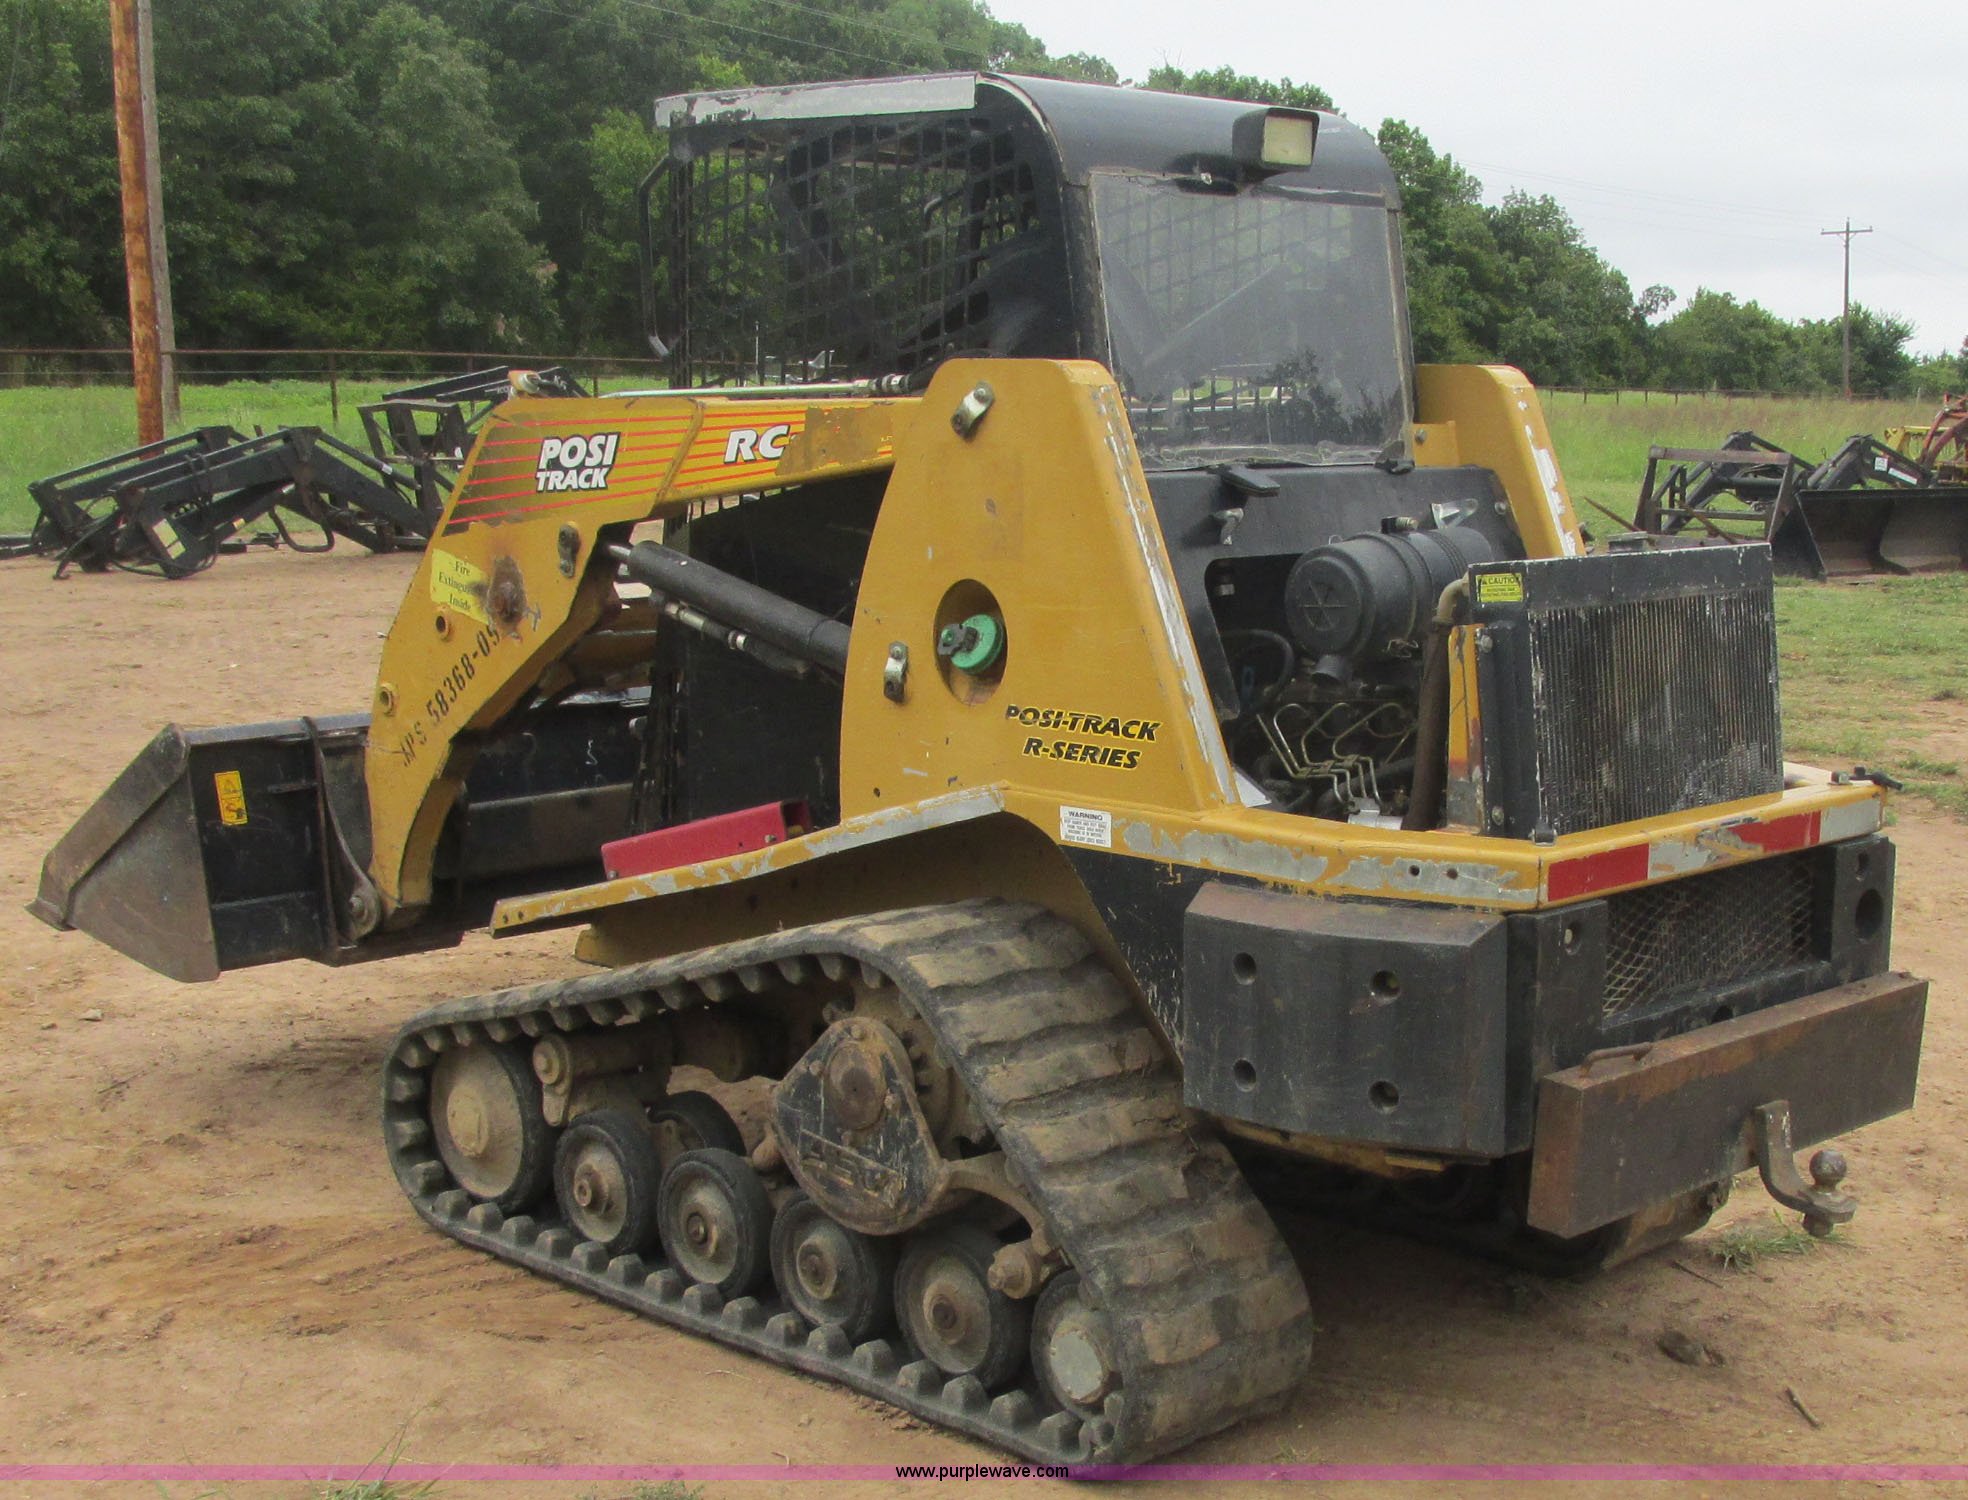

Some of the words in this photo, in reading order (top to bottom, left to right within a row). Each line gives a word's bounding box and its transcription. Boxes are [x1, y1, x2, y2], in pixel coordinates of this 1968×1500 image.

[538, 432, 620, 470] POSI
[535, 467, 610, 492] TRACK
[454, 561, 472, 577] Fire
[1005, 704, 1162, 742] POSI-TRACK
[1022, 736, 1141, 770] R-SERIES
[1068, 810, 1103, 821] WARNING
